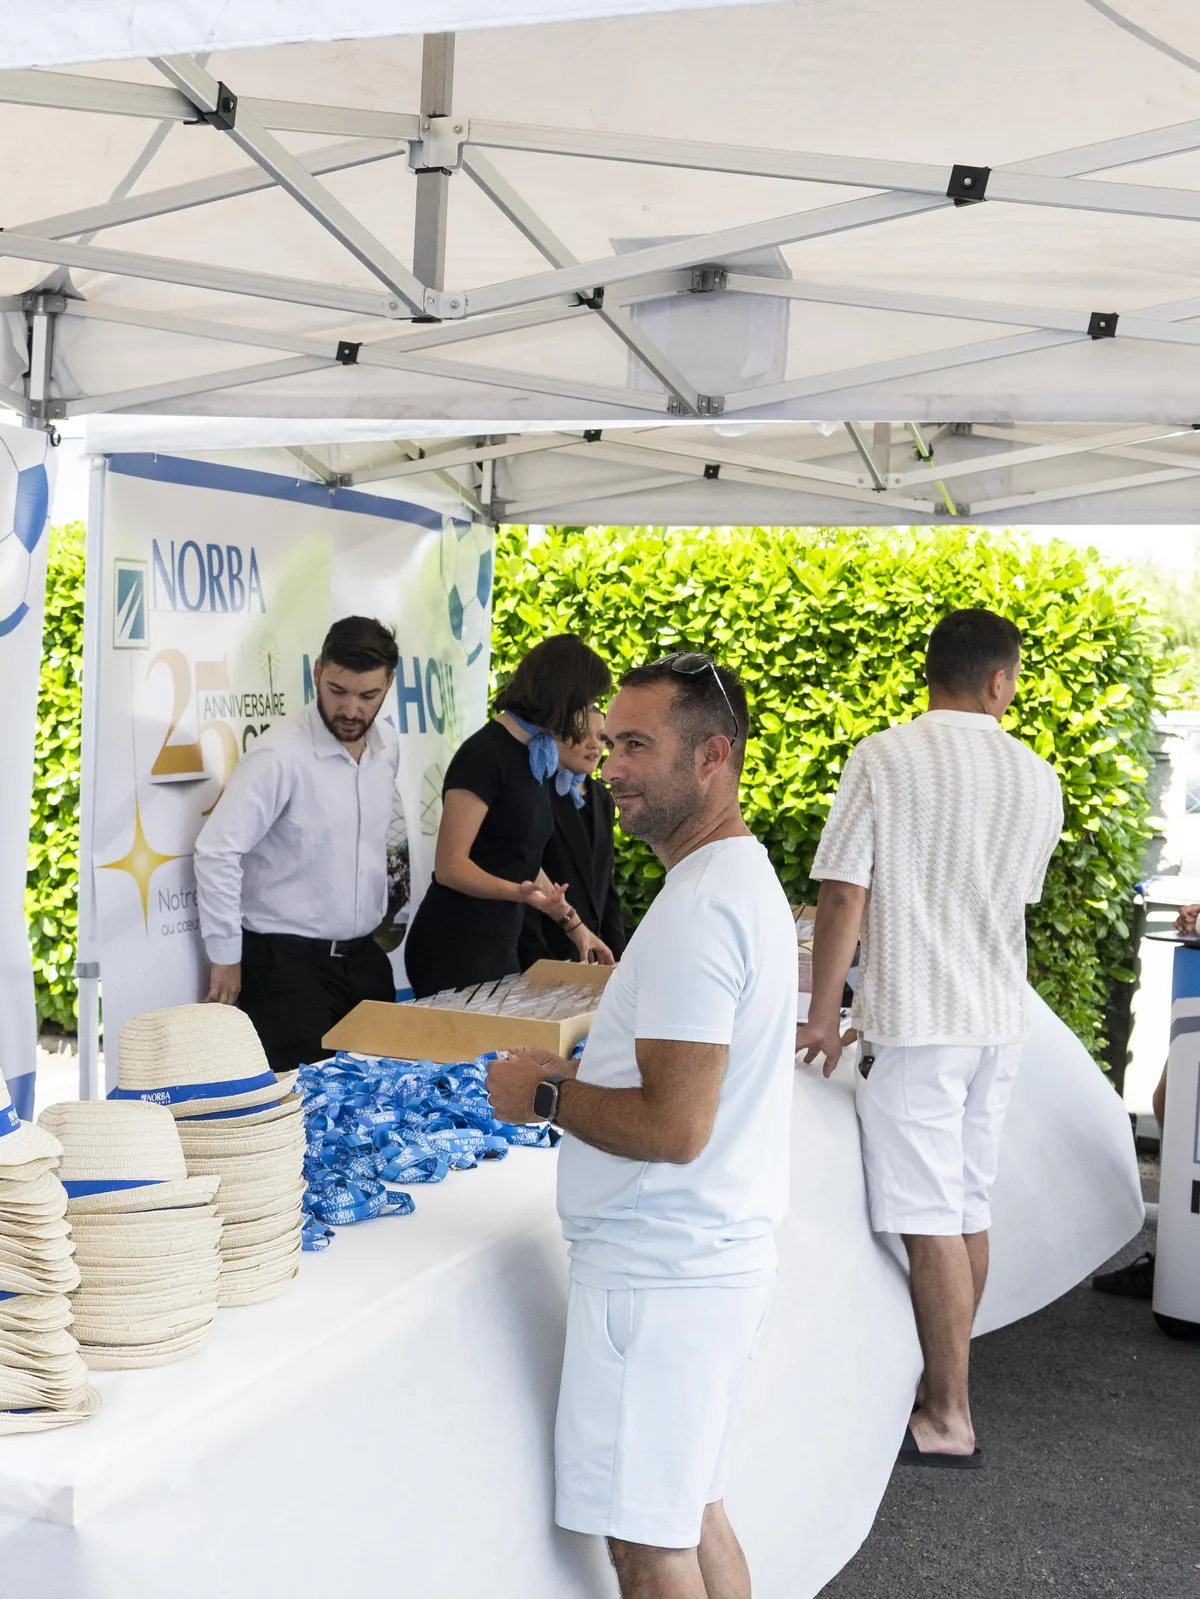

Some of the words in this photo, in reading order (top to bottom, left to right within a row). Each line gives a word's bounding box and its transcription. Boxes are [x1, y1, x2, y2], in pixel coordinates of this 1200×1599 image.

[152, 538, 266, 614] NORBA
[203, 692, 286, 720] ANNIVERSAIRE
[161, 924, 175, 936] au
[146, 1091, 171, 1102] NORBA
[327, 1192, 354, 1206] NORBA
[327, 1210, 355, 1221] NORBA
